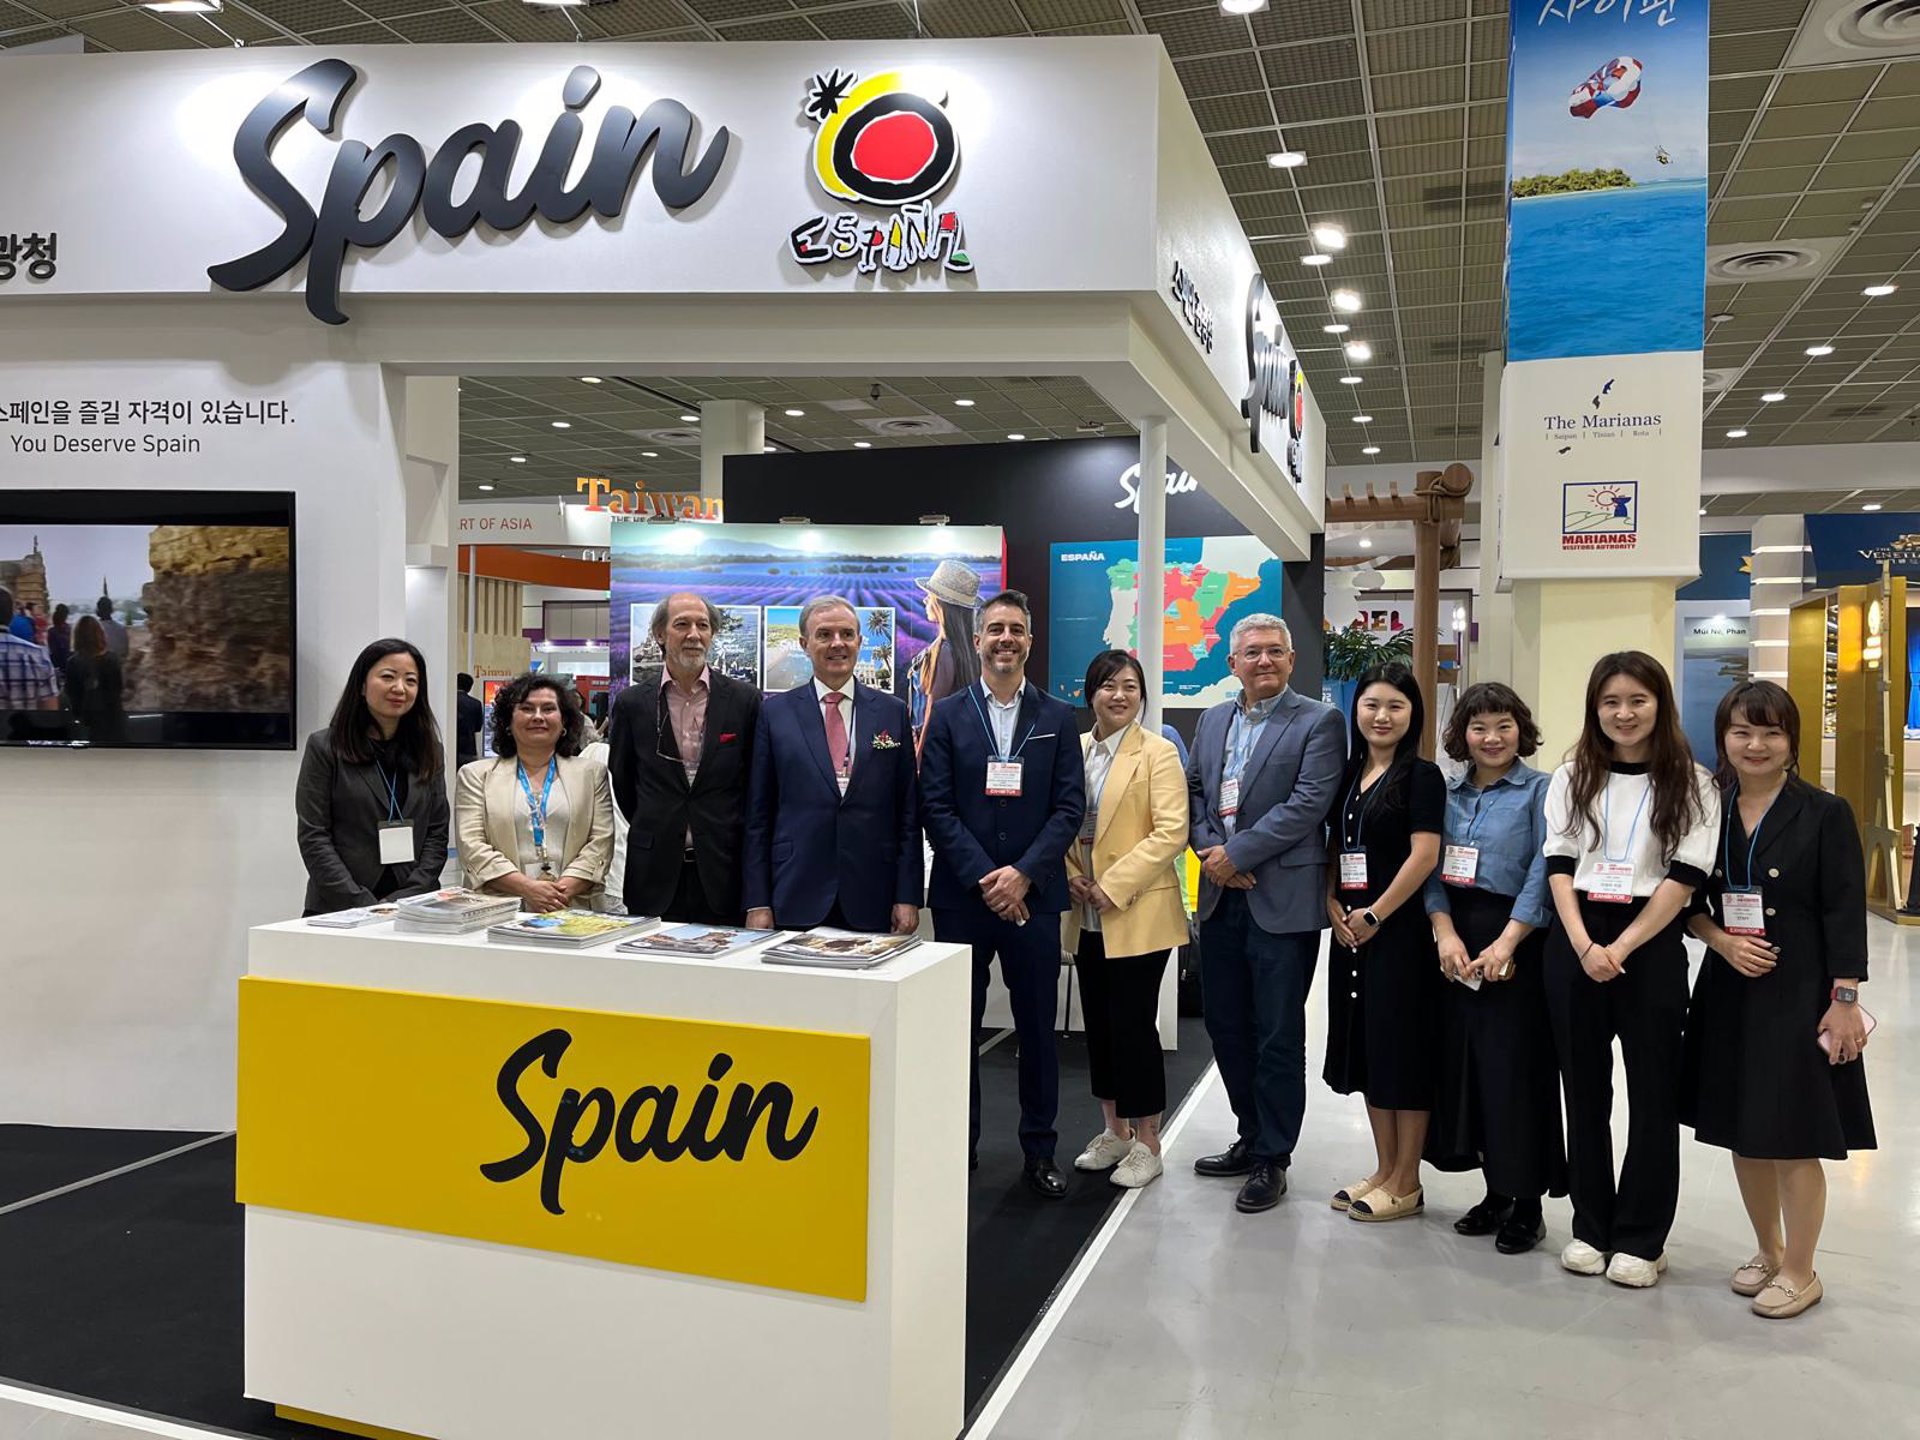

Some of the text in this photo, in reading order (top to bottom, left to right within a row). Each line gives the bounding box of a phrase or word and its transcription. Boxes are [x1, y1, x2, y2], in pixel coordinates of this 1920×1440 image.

[207, 58, 729, 325] Spain
[78, 400, 120, 424] 즐길
[128, 400, 192, 424] 자격이
[200, 400, 296, 424] 있습니다.
[1544, 413, 1662, 430] The Marianas
[11, 434, 200, 457] You Deserve Spain
[576, 477, 723, 520] Taiwan
[458, 517, 533, 531] RT OF ASIA
[1562, 534, 1637, 545] MARIANAS
[1061, 551, 1105, 562] ESPAÑA
[480, 1029, 818, 1215] Spain
